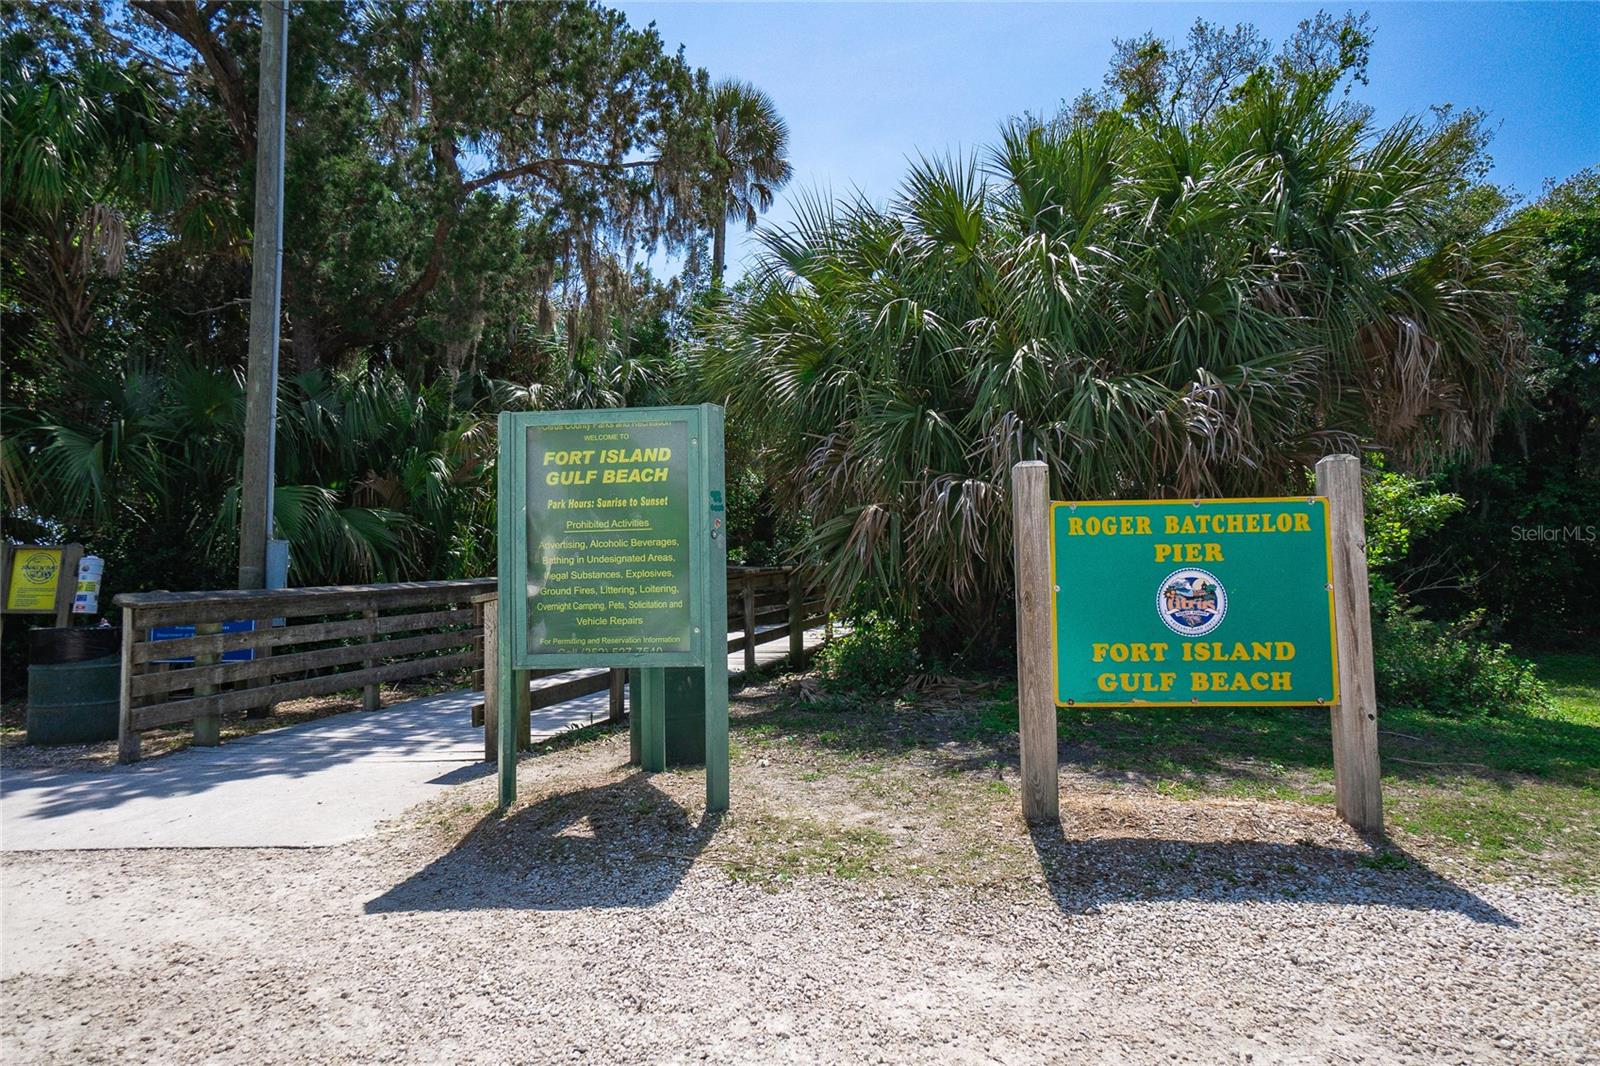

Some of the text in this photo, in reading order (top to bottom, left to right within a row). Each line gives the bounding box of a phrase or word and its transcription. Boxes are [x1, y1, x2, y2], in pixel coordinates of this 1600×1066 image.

[543, 448, 672, 466] FORT ISLAND
[545, 468, 670, 486] GULF BEACH
[547, 496, 669, 510] Park Hours: Sunrise to Sunset
[566, 519, 650, 529] Prohibited Activities
[1067, 512, 1312, 536] ROGER BATCHELOR
[590, 539, 629, 548] Alcoholic
[630, 538, 680, 548] Beverages,
[576, 555, 584, 564] in
[586, 554, 646, 565] Undesignated
[647, 554, 676, 563] Areas,
[1153, 543, 1225, 563] PIER
[570, 570, 624, 580] Substances,
[626, 569, 675, 580] Explosives,
[540, 584, 680, 596] Ground Fires, Littering, Loitering,
[536, 600, 683, 613] Overnight Camping, Pets, Solicitation and
[1167, 595, 1217, 611] Citrus
[576, 616, 644, 626] Vehicle Repairs
[552, 638, 586, 646] Permitting
[587, 636, 601, 644] and
[602, 636, 642, 644] Reservation
[643, 636, 681, 644] Information
[1092, 641, 1297, 663] FORT ISLAND
[1096, 671, 1294, 692] GULF BEACH
